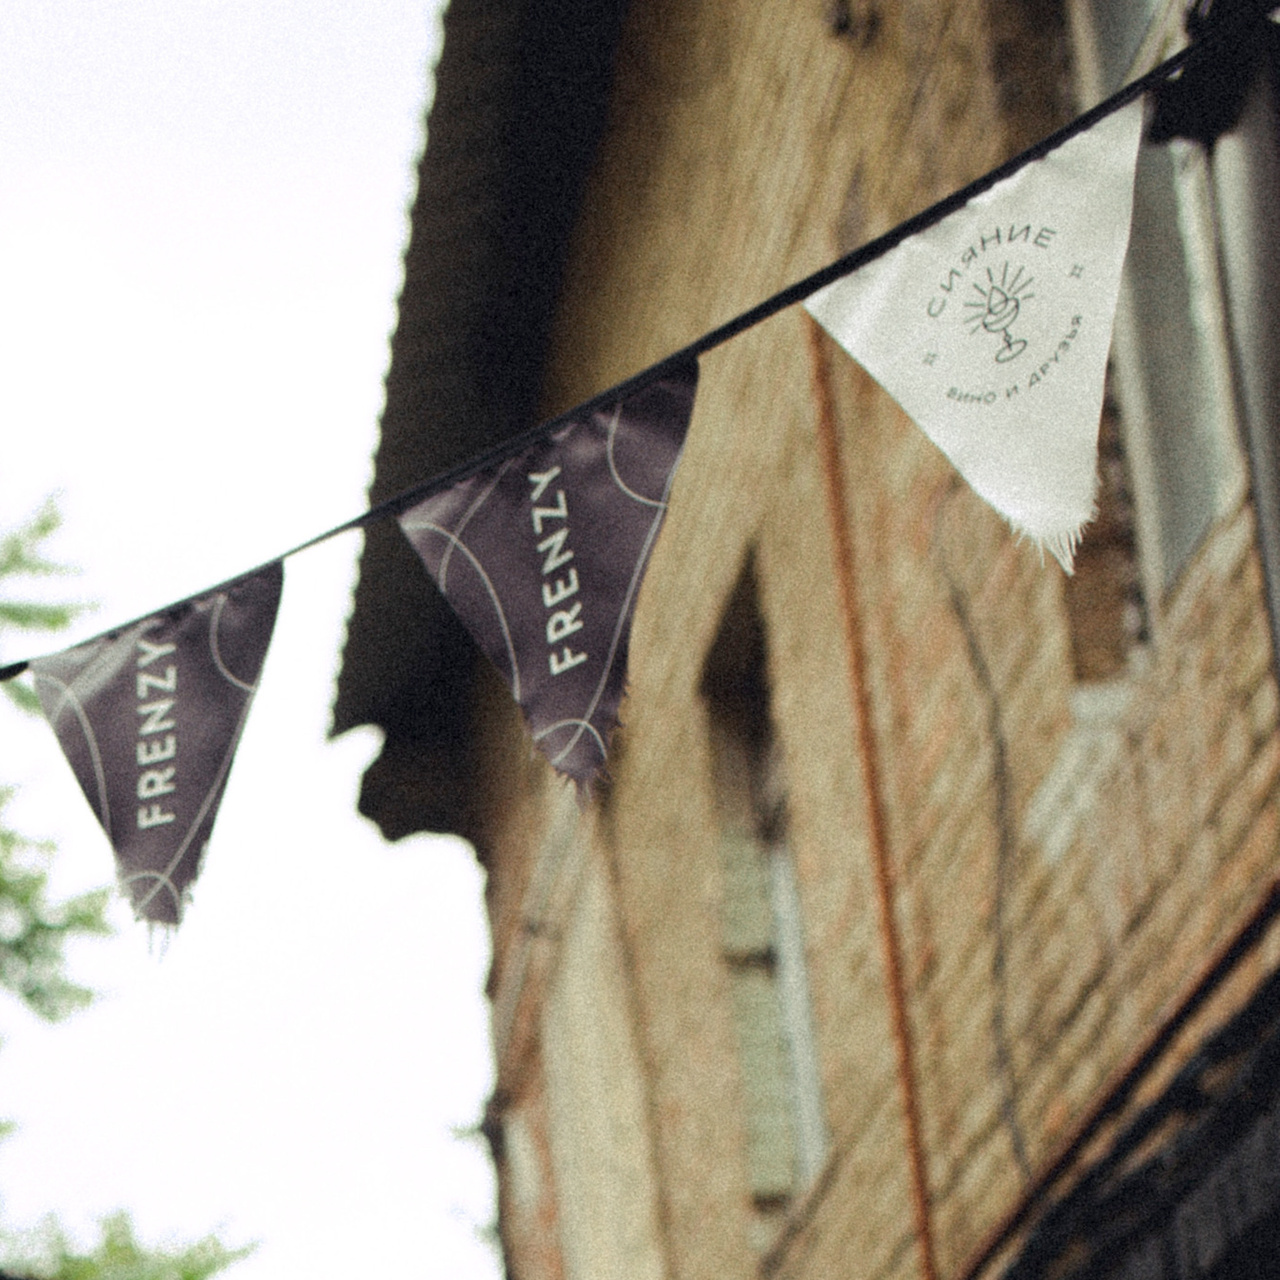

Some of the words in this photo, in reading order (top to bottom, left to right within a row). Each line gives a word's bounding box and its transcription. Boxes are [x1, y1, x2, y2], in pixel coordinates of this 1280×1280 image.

[928, 225, 1056, 317] СИЯНИЕ
[947, 388, 996, 404] ВИНО
[1006, 385, 1019, 401] И
[1029, 315, 1082, 388] ДРУЗЬЯ
[528, 466, 588, 676] FRENZY
[136, 638, 177, 830] FRENZY
